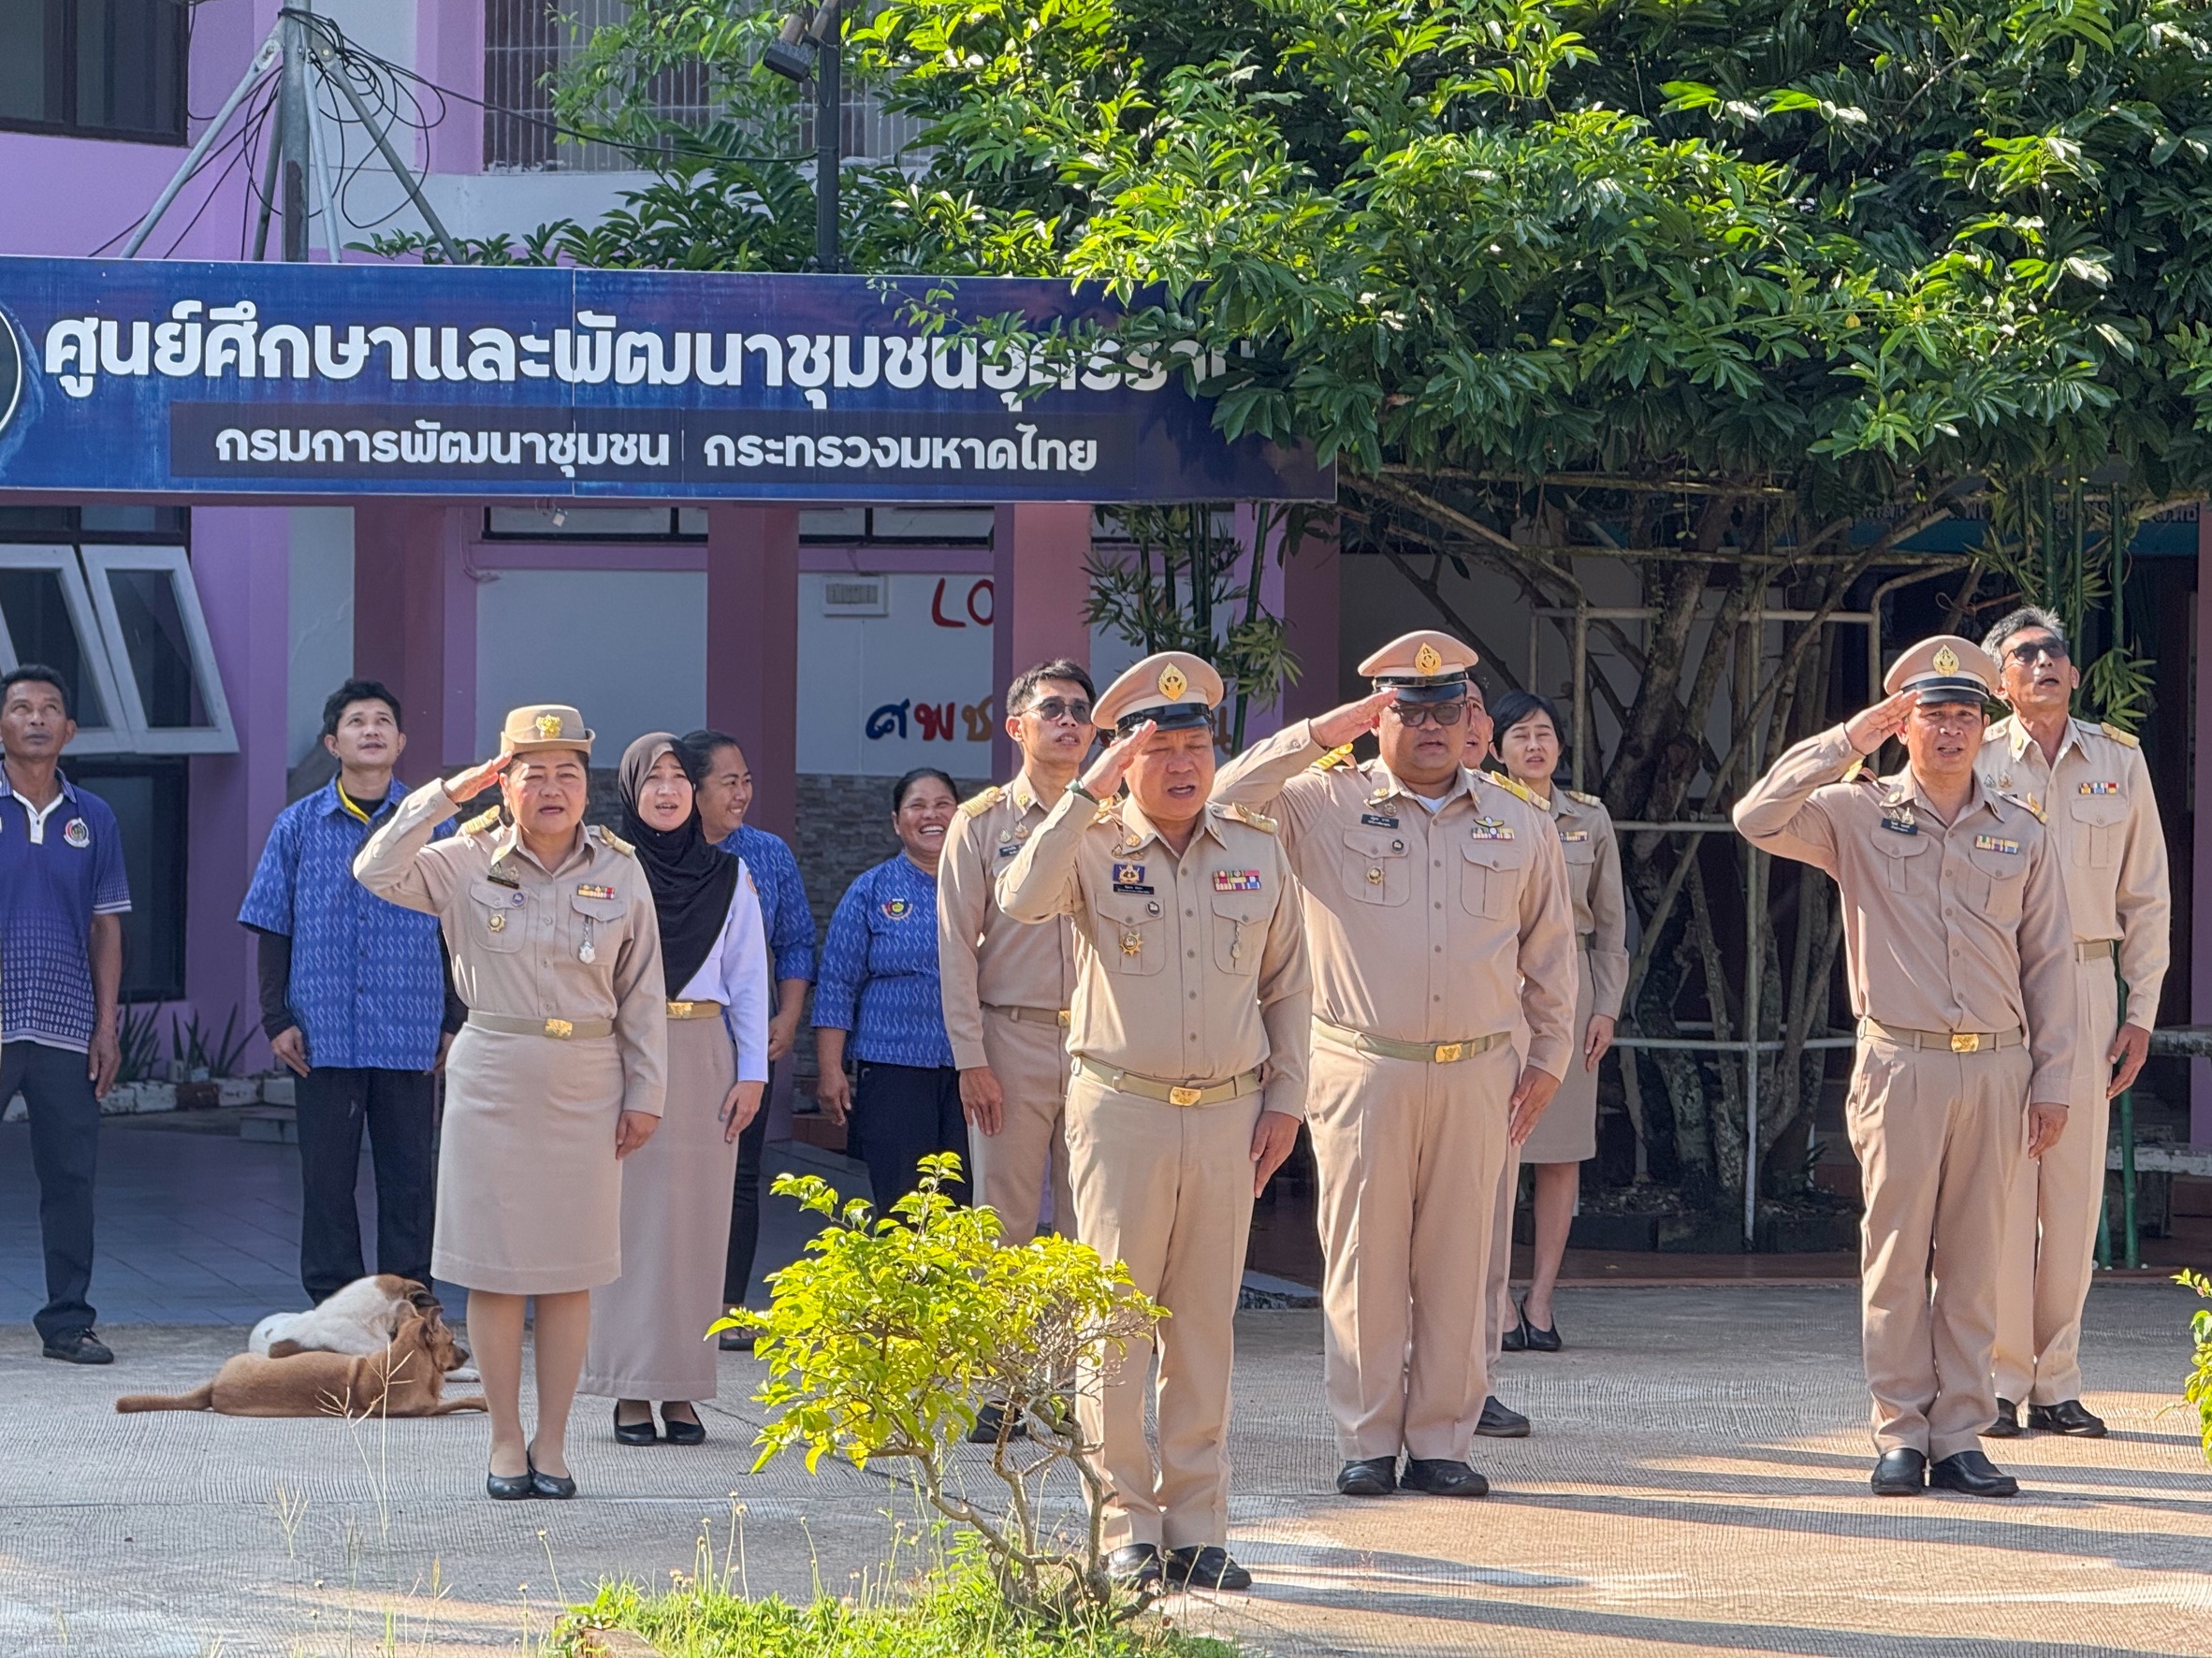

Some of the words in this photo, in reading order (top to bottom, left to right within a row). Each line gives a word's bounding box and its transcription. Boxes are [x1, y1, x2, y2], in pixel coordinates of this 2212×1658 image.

[215, 419, 669, 478] กรมการพัฒนาชุมชน
[704, 424, 1099, 472] กระทรวงมหาดไทย
